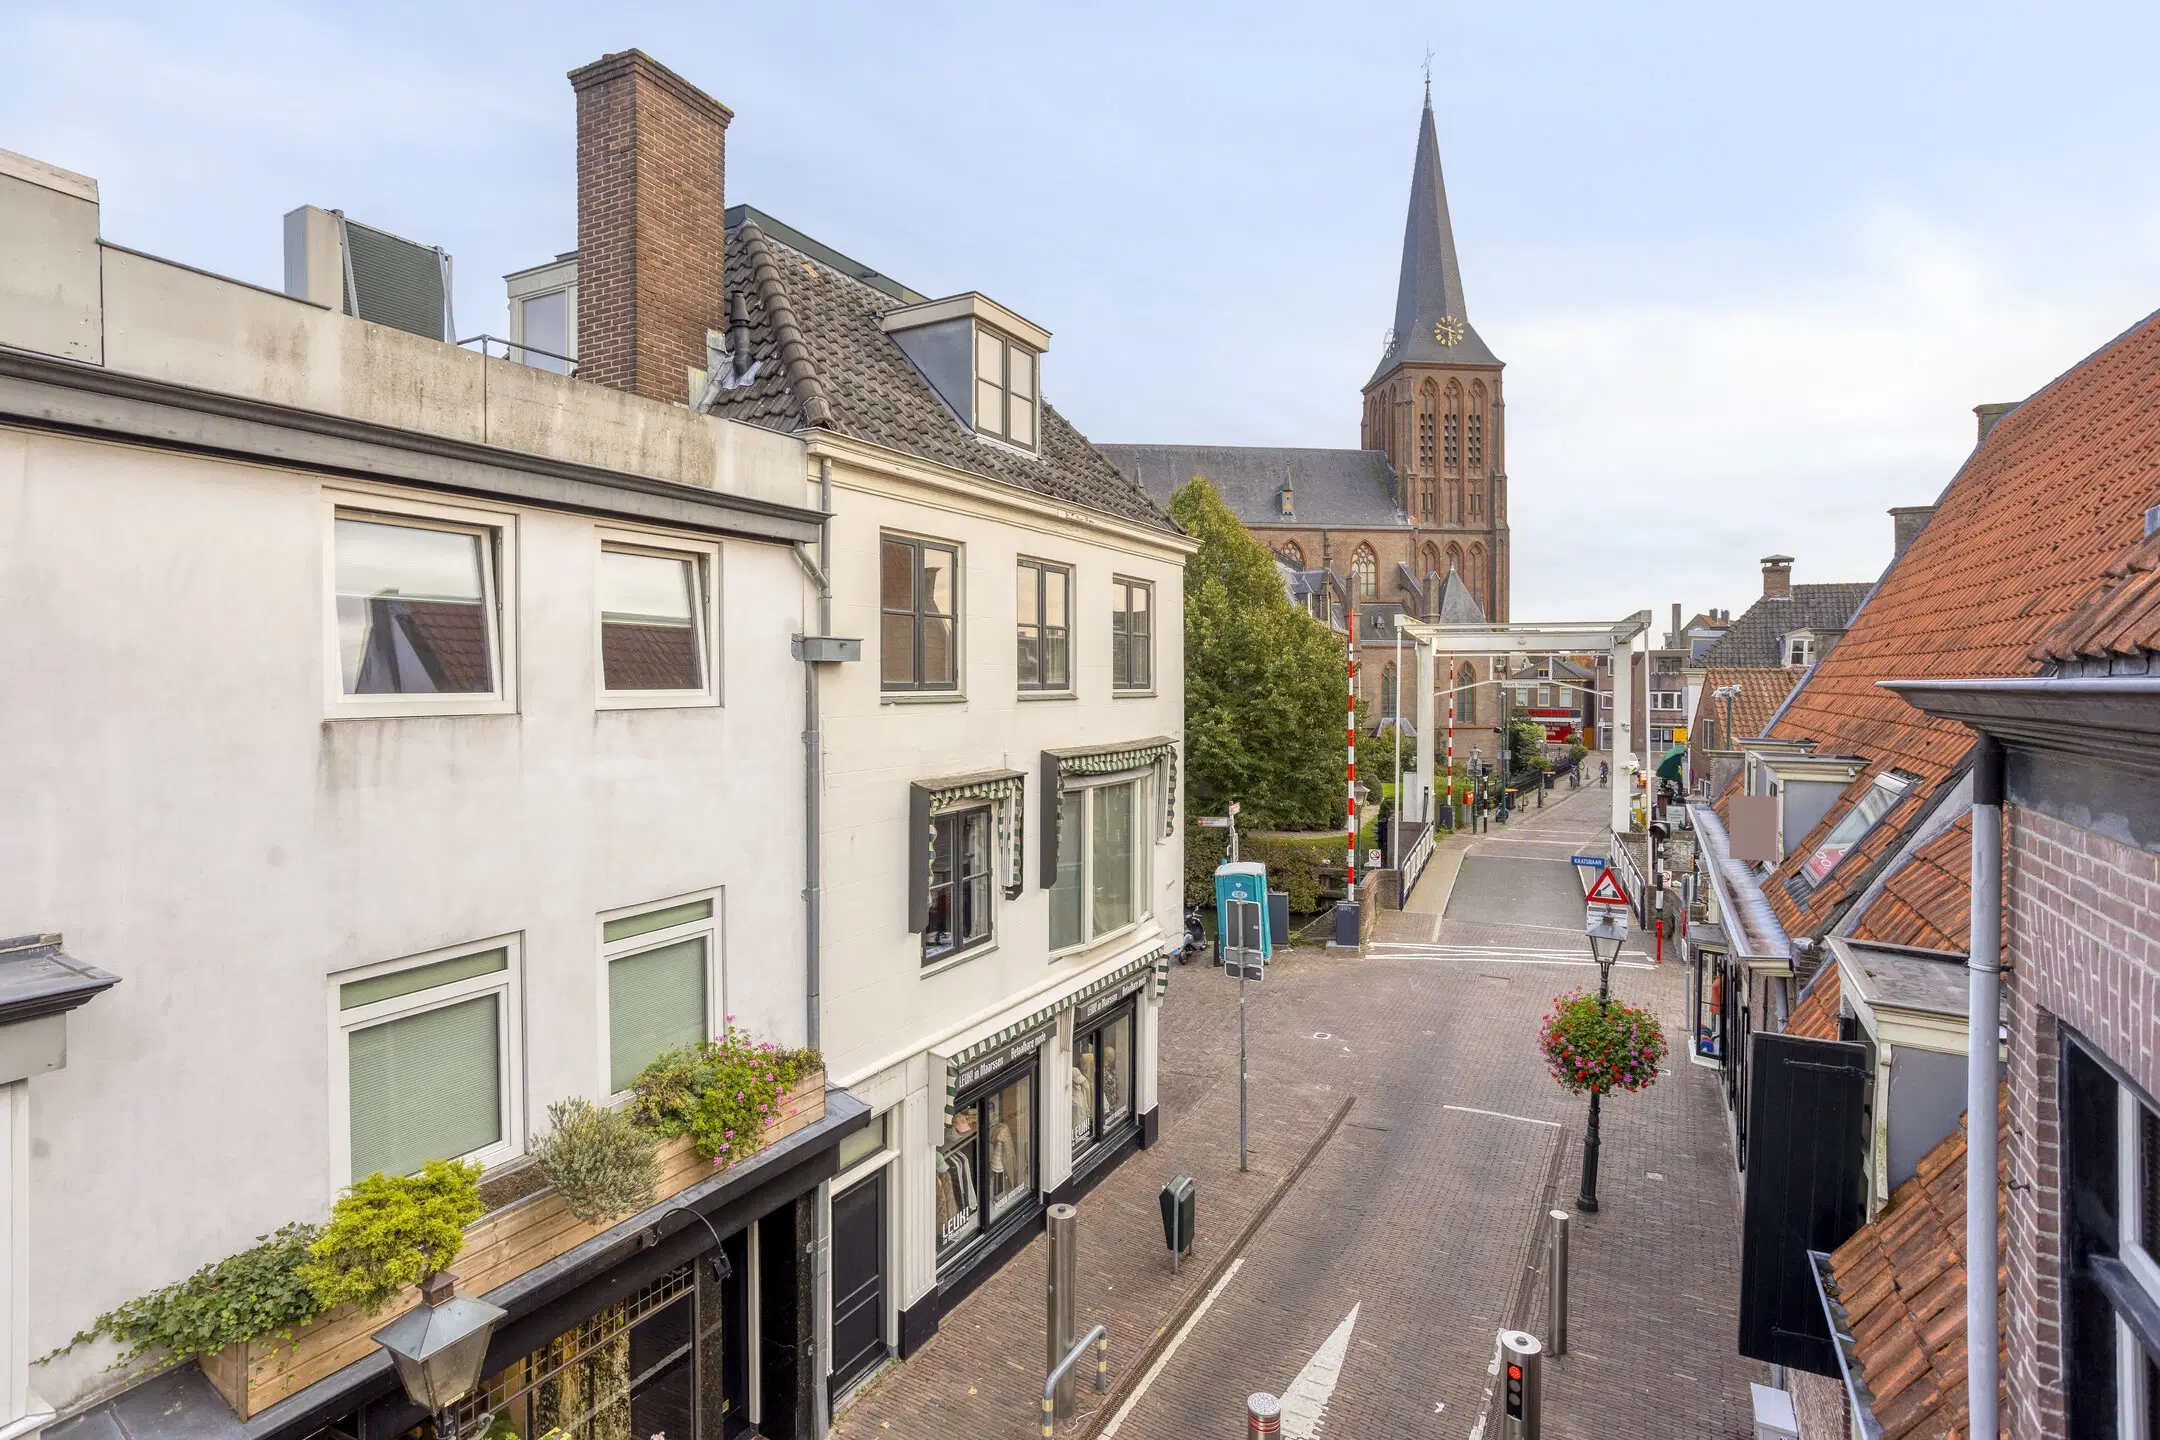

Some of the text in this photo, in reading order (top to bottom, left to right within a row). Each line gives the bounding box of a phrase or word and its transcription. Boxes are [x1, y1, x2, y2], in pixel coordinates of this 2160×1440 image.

[1573, 858, 1603, 866] KAATSBAAN
[959, 1031, 1047, 1088] LEUK! in Maarssen Betaalbare mode
[1071, 1117, 1090, 1141] LEUK!
[942, 1206, 969, 1238] LEUK!
